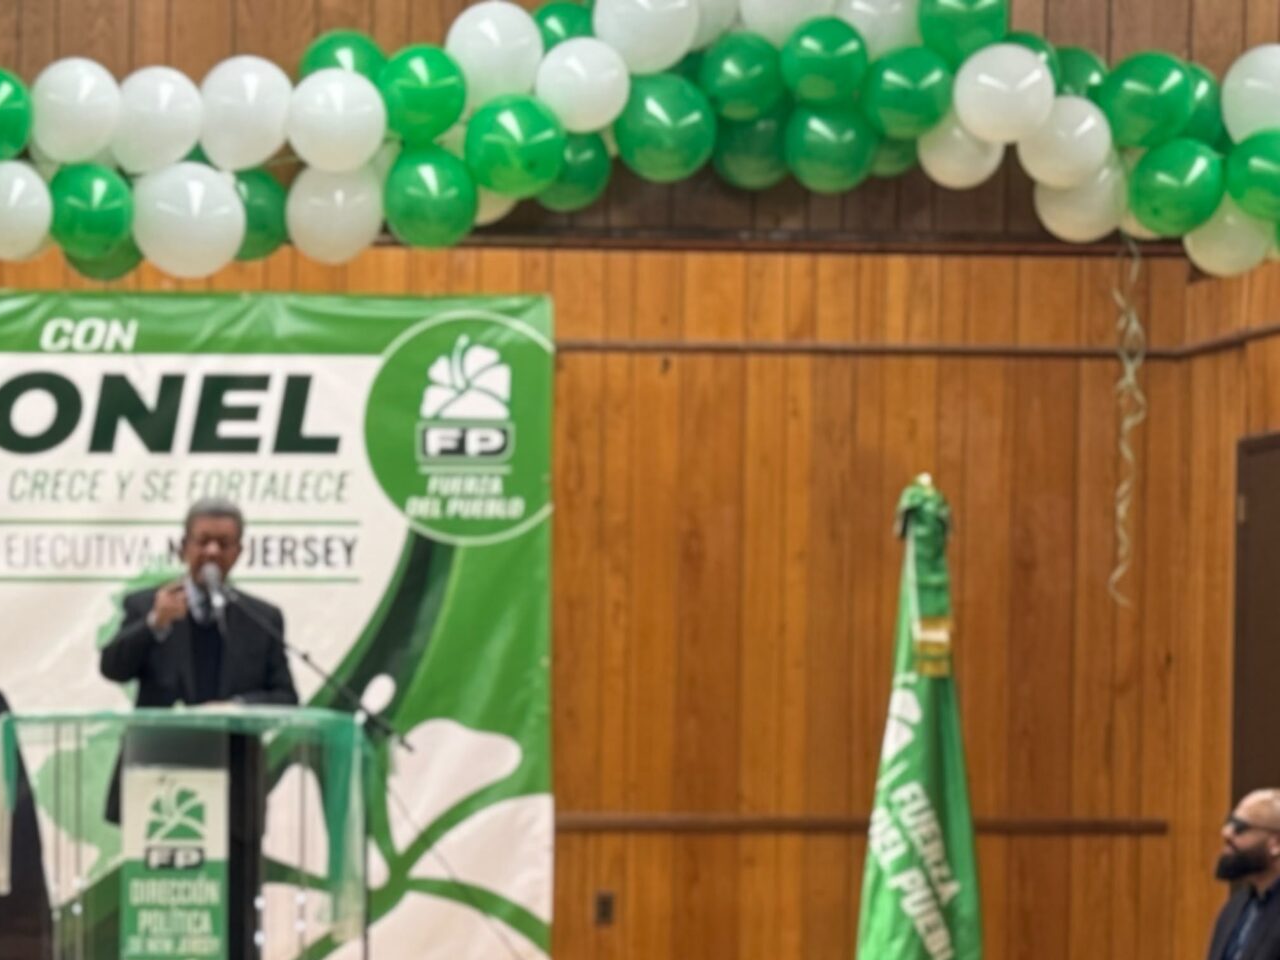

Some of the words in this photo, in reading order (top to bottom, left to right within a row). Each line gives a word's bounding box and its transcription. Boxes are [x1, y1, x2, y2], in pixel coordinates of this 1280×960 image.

[40, 317, 138, 352] CON
[425, 427, 506, 457] FP
[8, 468, 104, 502] CRECE
[116, 469, 135, 502] Y
[140, 469, 177, 502] SE
[186, 469, 353, 503] FORTALECE
[426, 474, 504, 497] FUERZA
[405, 496, 443, 519] DEL
[445, 496, 526, 519] PUEBLO
[5, 533, 154, 569] EJECUTIVA
[246, 535, 360, 568] JERSEY
[148, 849, 202, 869] FP
[888, 782, 961, 906] FUERZA
[129, 872, 221, 906] DIRECCIÓN
